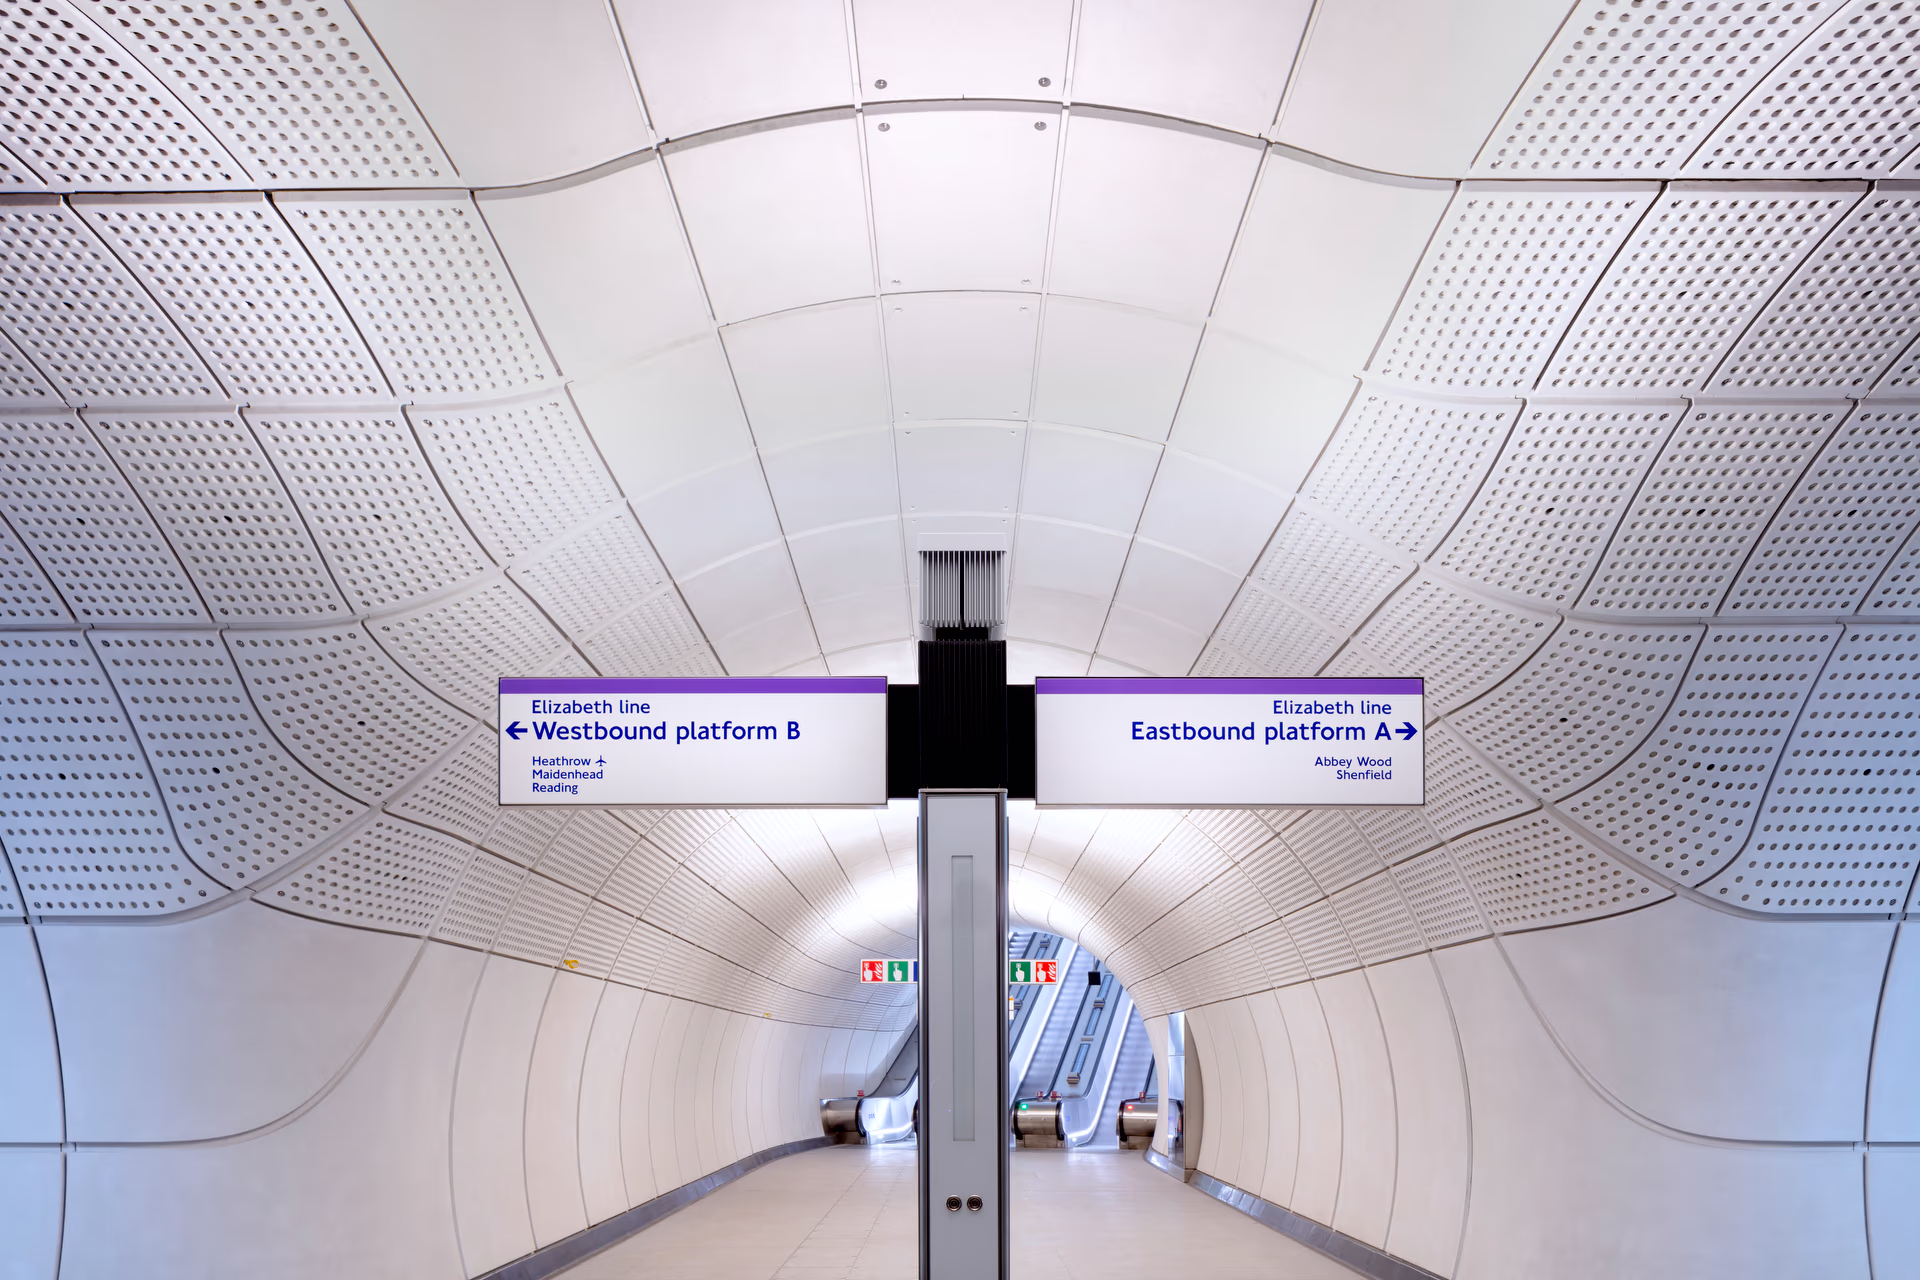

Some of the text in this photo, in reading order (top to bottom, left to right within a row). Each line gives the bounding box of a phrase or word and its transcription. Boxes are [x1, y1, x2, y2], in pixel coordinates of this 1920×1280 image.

[532, 699, 651, 714] Elizabeth line
[1273, 699, 1392, 715] Elizabeth line
[532, 721, 801, 745] Westbound platform B
[1131, 721, 1392, 745] Eastbound platform A
[532, 755, 591, 767] Heathrow
[1314, 756, 1392, 768] Abbey Wood
[532, 769, 604, 780] Maidenhead
[1336, 769, 1392, 780] Shenfield
[532, 782, 579, 794] Reading
